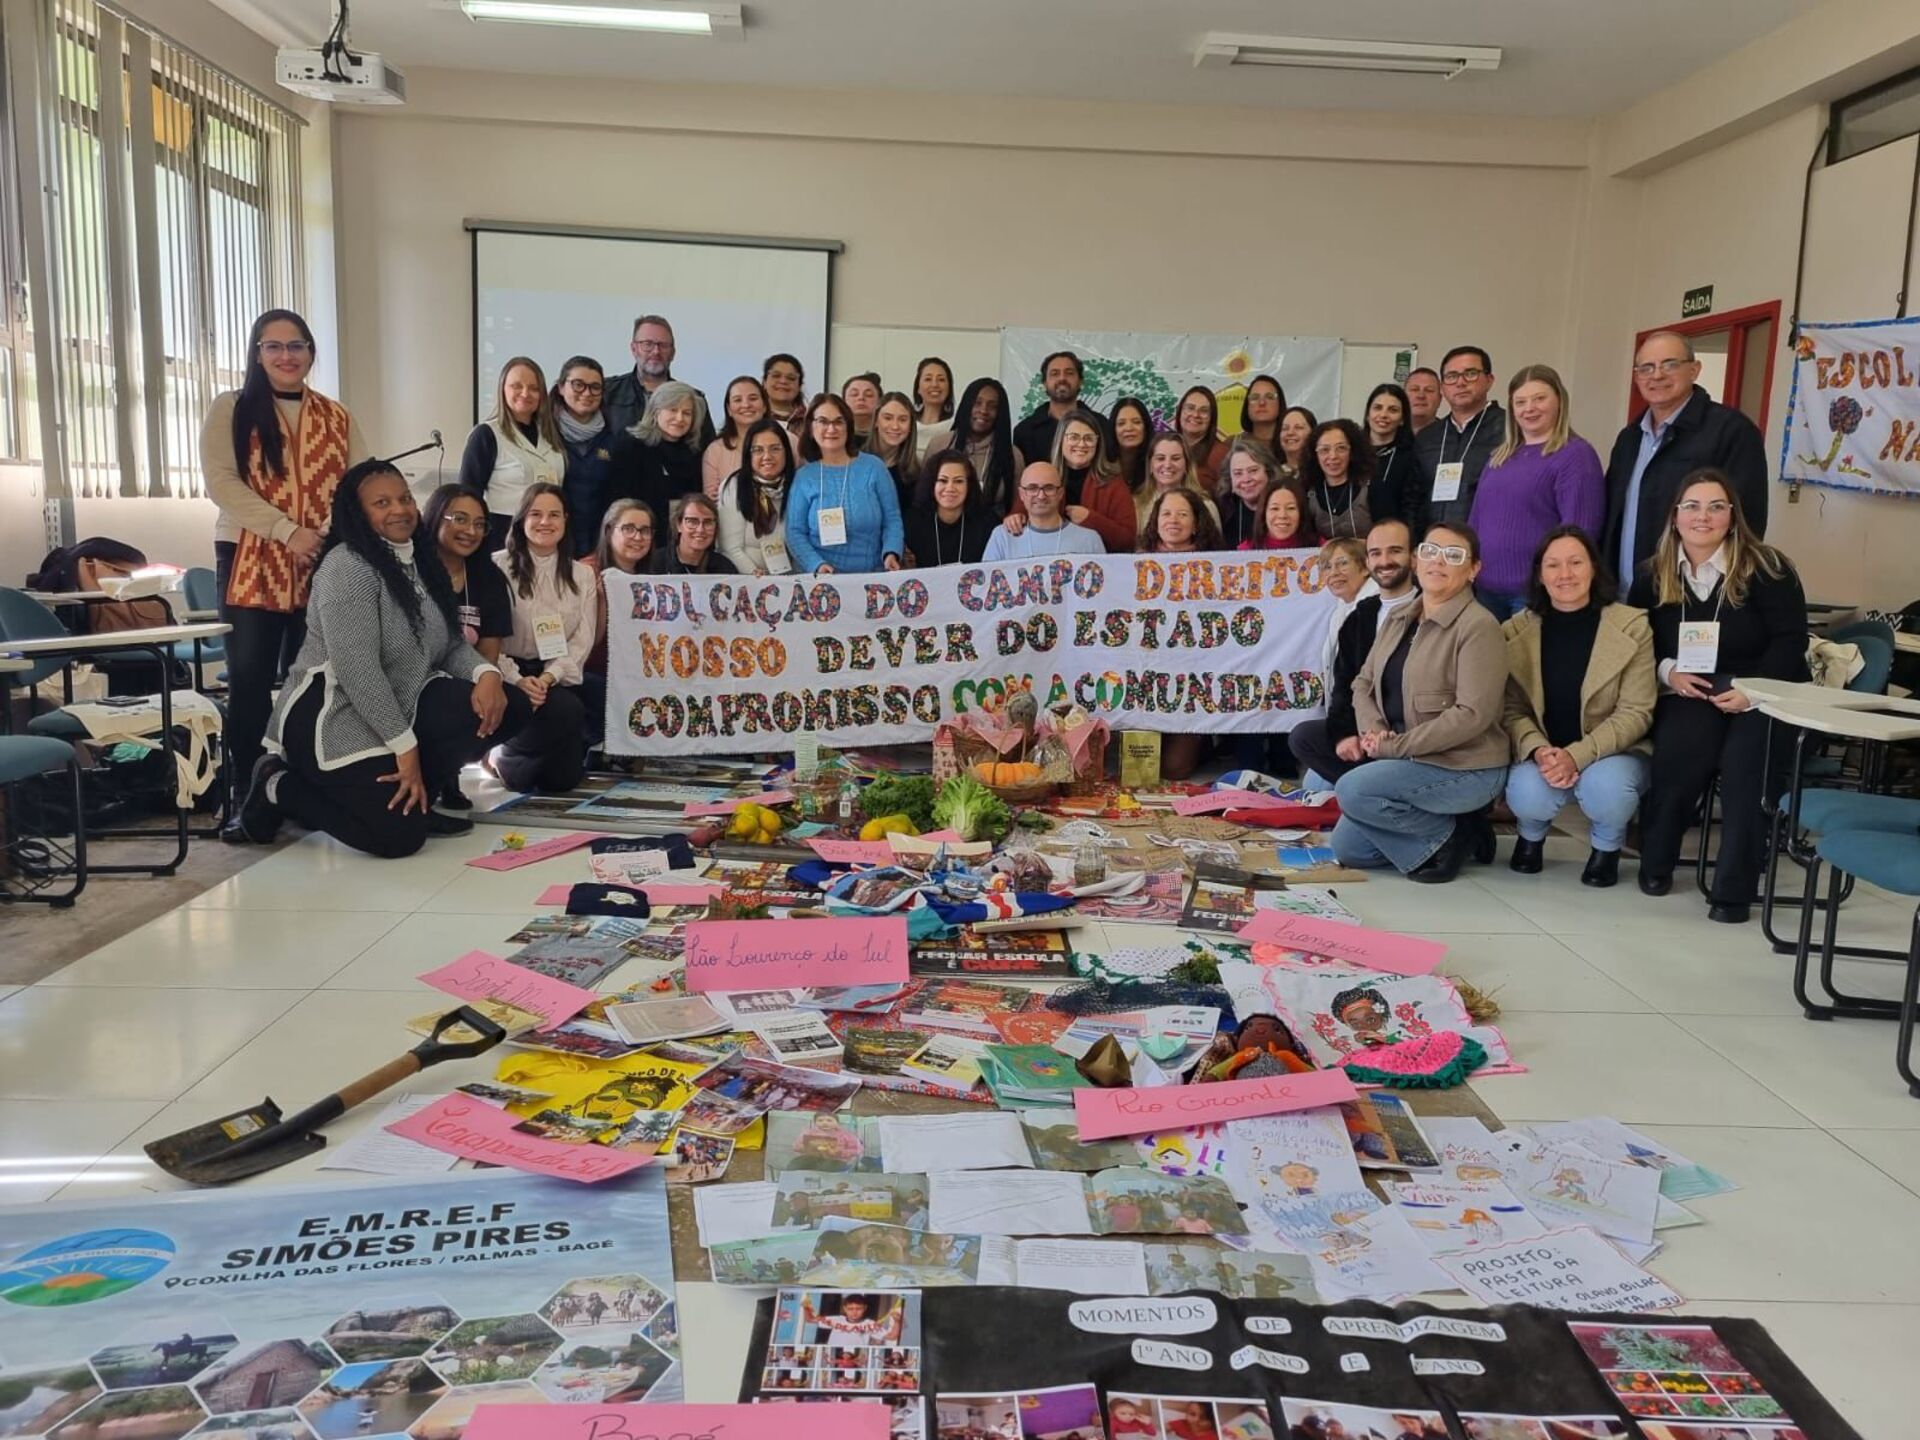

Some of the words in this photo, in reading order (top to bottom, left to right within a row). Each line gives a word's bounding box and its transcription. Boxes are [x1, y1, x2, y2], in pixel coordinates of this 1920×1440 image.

[1683, 294, 1711, 313] SAÍDA
[1816, 346, 1920, 389] ESCOL
[864, 578, 930, 619] DO
[957, 559, 1105, 612] CAMPO
[1134, 555, 1327, 602] DIREITO
[639, 631, 787, 678] NOSSO
[812, 622, 979, 673] DEVER
[996, 612, 1059, 656] DO
[1073, 606, 1265, 649] ESTADO
[628, 682, 942, 738] COMPROMISSO
[1044, 673, 1069, 708] A
[1074, 669, 1327, 714] COMUNIDAD
[822, 942, 848, 962] do
[1112, 1089, 1162, 1115] Rio
[1176, 1083, 1301, 1113] Grande
[298, 1203, 516, 1238] E.M.R.E.F
[182, 1270, 285, 1287] COXILHA
[294, 1265, 339, 1277] DAS
[346, 1256, 433, 1273] FLORES
[452, 1248, 538, 1264] PALMAS
[557, 1239, 617, 1253] BAGÉ
[221, 1234, 416, 1270] SIMÕES
[432, 1221, 571, 1252] PIRES
[1479, 1267, 1542, 1290] PASTA
[1553, 1258, 1580, 1270] DA
[1077, 1304, 1206, 1324] MOMENTOS
[1254, 1318, 1286, 1332] DE
[1326, 1318, 1501, 1339] APRENDIZAGEM
[1159, 1347, 1209, 1366] ANO
[1256, 1351, 1305, 1371] ANO
[1349, 1356, 1363, 1370] E
[1431, 1360, 1482, 1373] ANO
